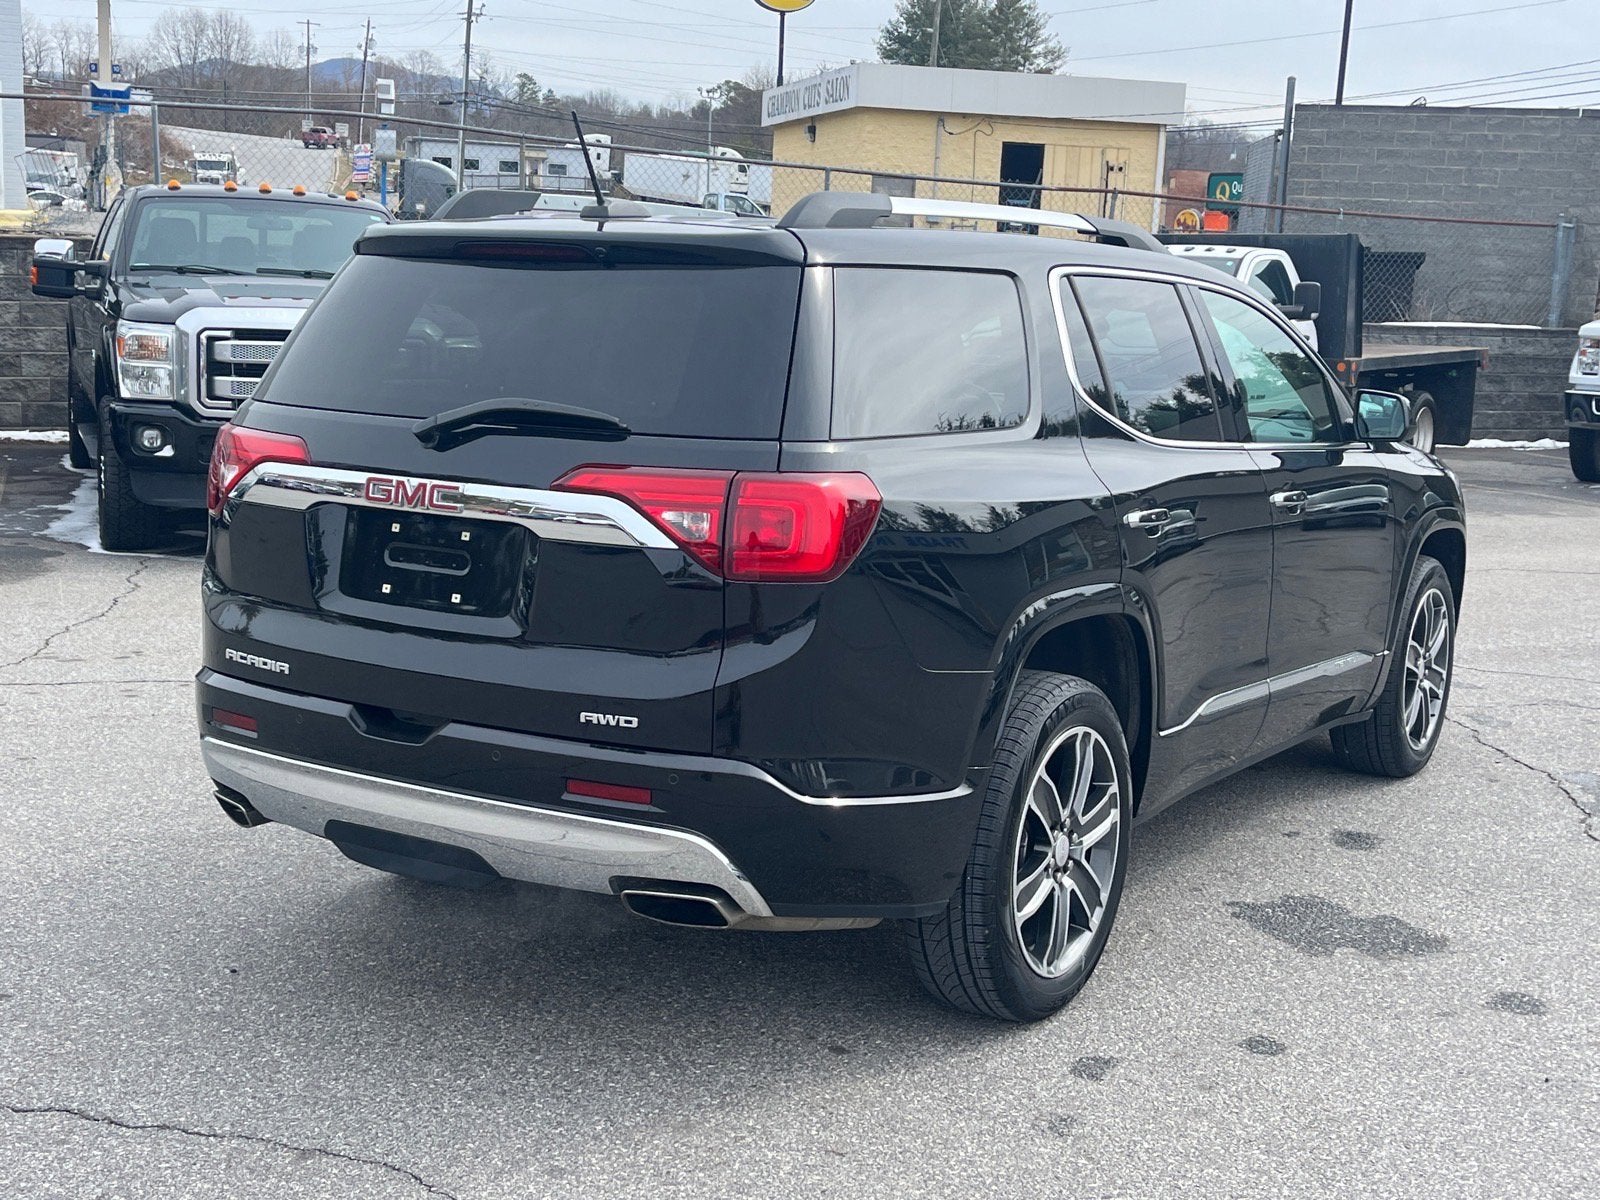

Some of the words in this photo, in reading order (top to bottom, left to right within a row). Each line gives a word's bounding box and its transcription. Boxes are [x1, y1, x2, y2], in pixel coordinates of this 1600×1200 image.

[767, 87, 801, 118] CHAMPION
[802, 82, 822, 110] CUTS
[825, 74, 851, 105] SALON
[365, 476, 464, 513] GMC
[225, 648, 290, 675] ACADIA
[580, 711, 639, 728] AWD
